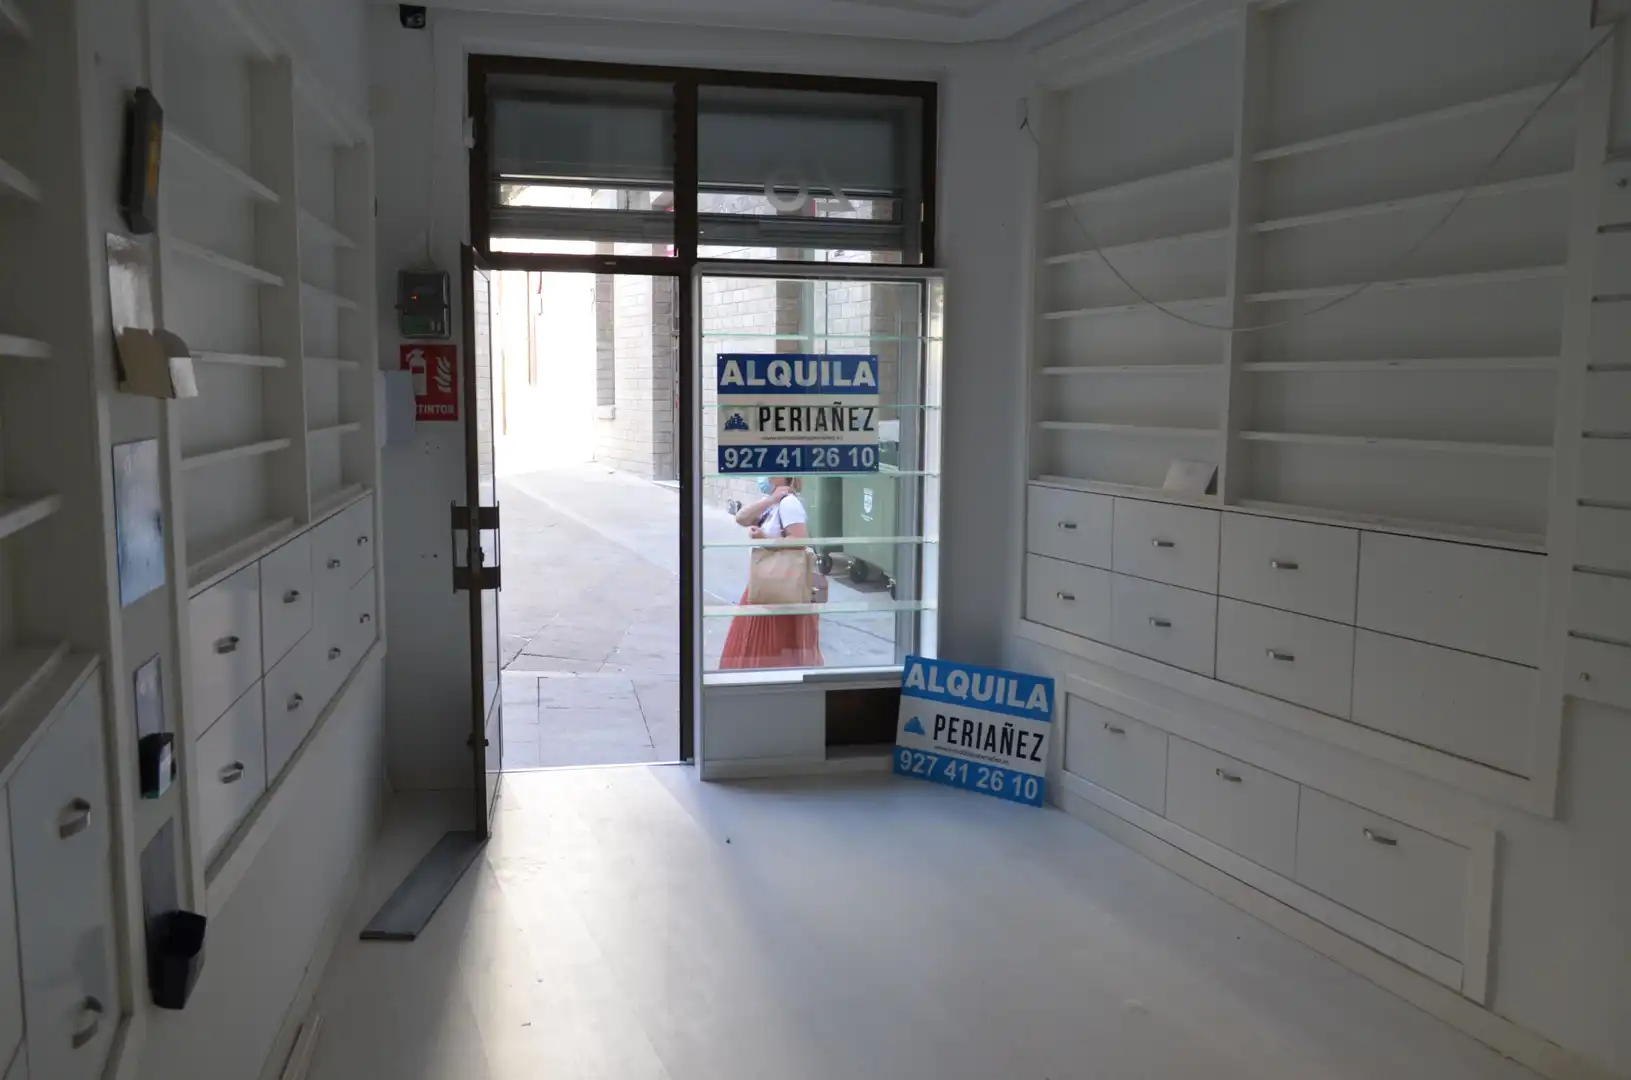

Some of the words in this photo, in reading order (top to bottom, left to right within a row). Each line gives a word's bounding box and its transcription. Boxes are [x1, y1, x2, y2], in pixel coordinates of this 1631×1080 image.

[720, 360, 876, 388] ALQUILA
[416, 403, 455, 415] TINTOR
[759, 401, 874, 432] PERIAÑEZ
[724, 447, 768, 469] 927
[775, 447, 801, 468] 41
[812, 447, 840, 468] 26
[848, 447, 874, 468] 10
[905, 662, 1049, 713] ALQUILA
[933, 713, 1044, 762] PERIAÑEZ
[900, 750, 938, 776] 927
[943, 760, 969, 785] 41
[976, 767, 1004, 792] 26
[1012, 774, 1038, 800] 10
